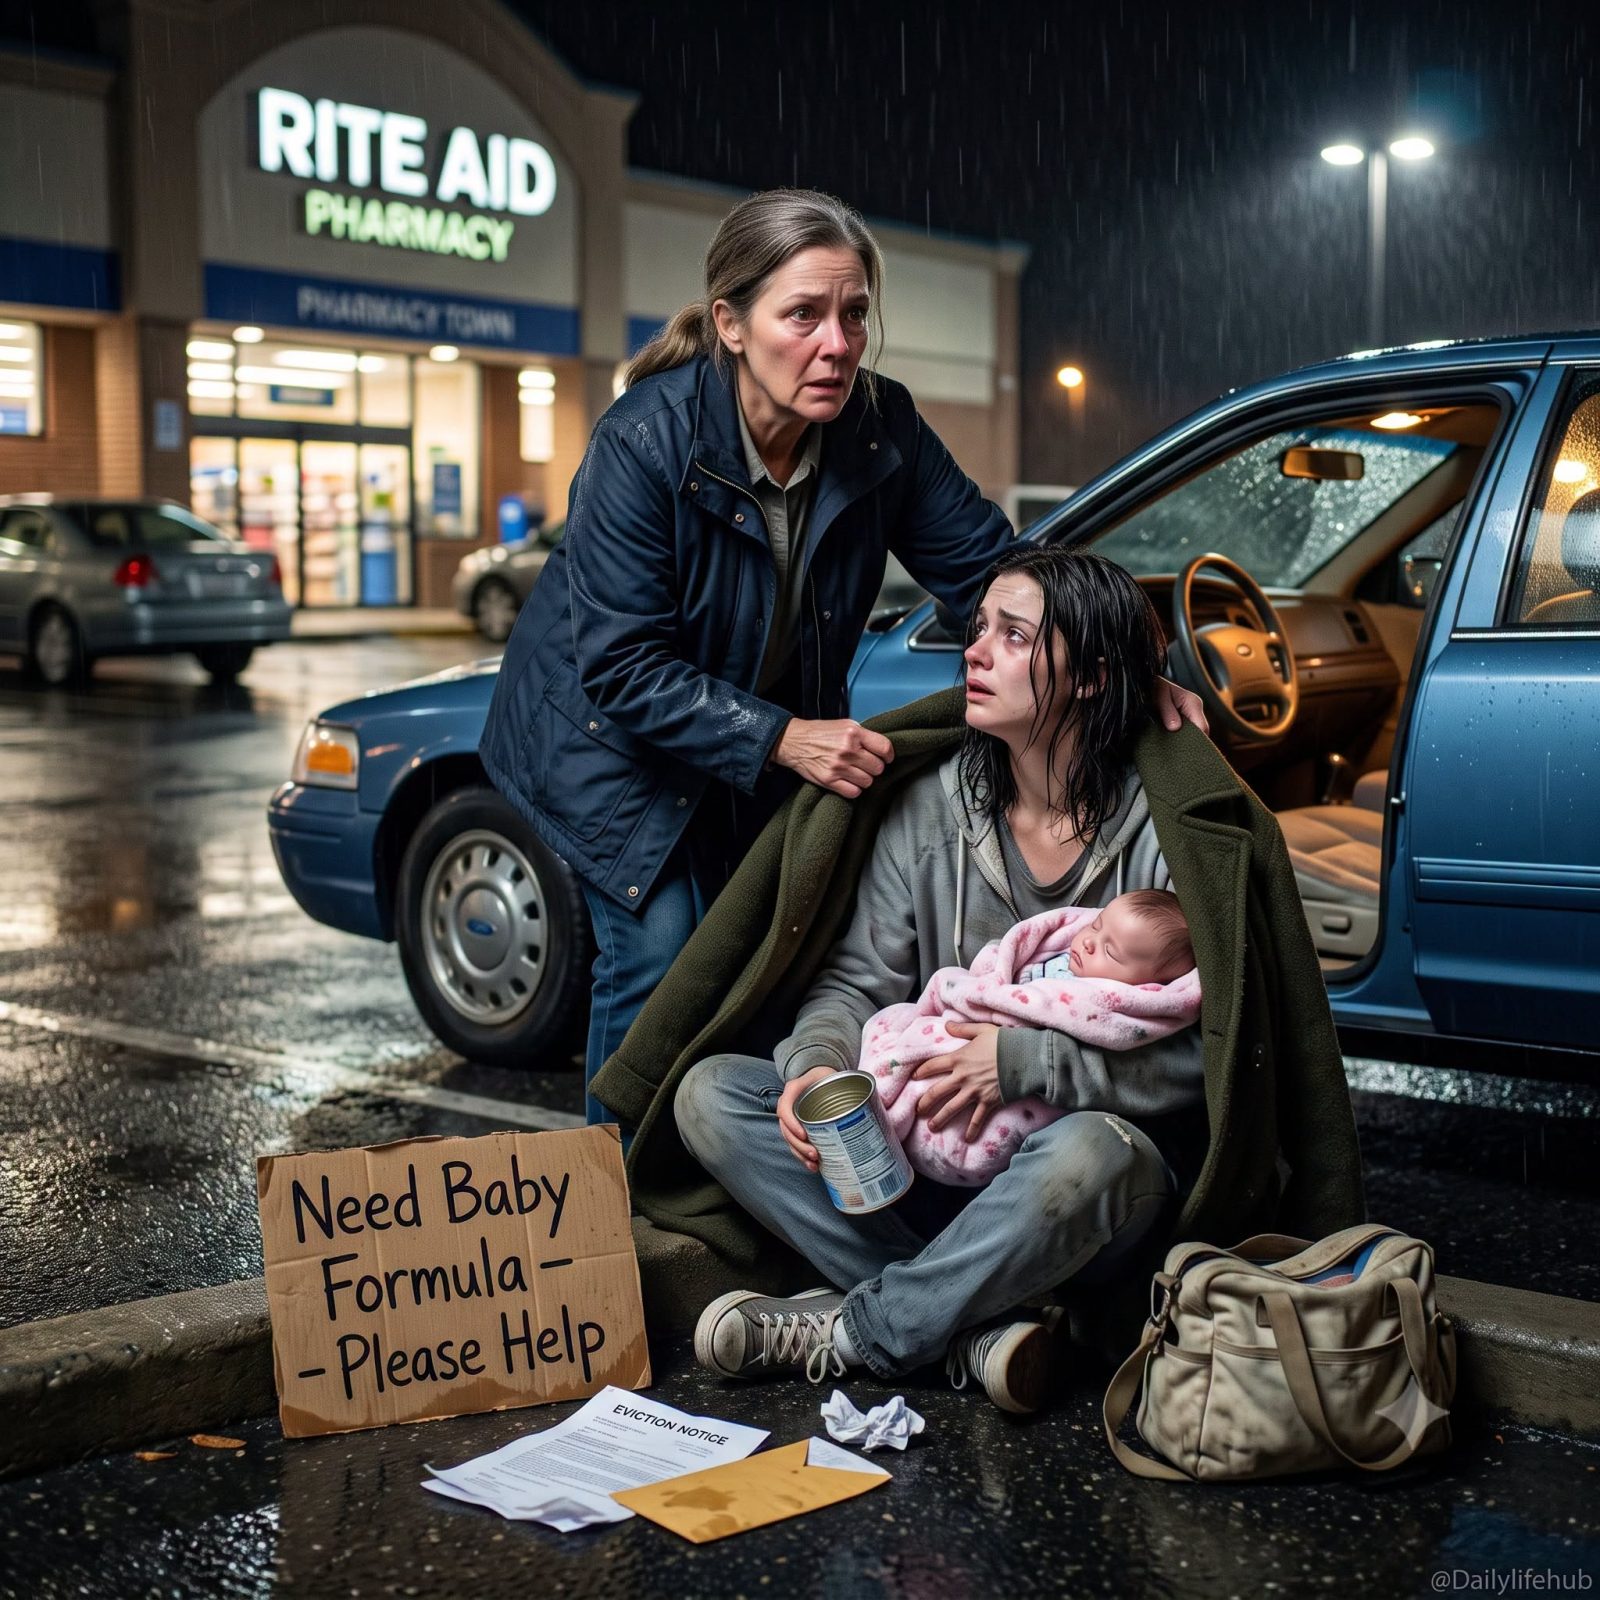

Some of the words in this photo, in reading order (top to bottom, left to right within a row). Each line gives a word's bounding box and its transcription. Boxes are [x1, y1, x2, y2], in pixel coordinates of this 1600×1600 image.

[258, 87, 429, 197] RITE
[436, 126, 557, 217] AID
[305, 188, 514, 262] PHARMACY
[292, 1163, 422, 1243] Need
[441, 1154, 570, 1238] Baby
[321, 1236, 528, 1321] Formula
[336, 1332, 486, 1399] Please
[500, 1304, 606, 1383] Help
[612, 1403, 677, 1431] EVICTION
[677, 1424, 729, 1446] NOTICE
